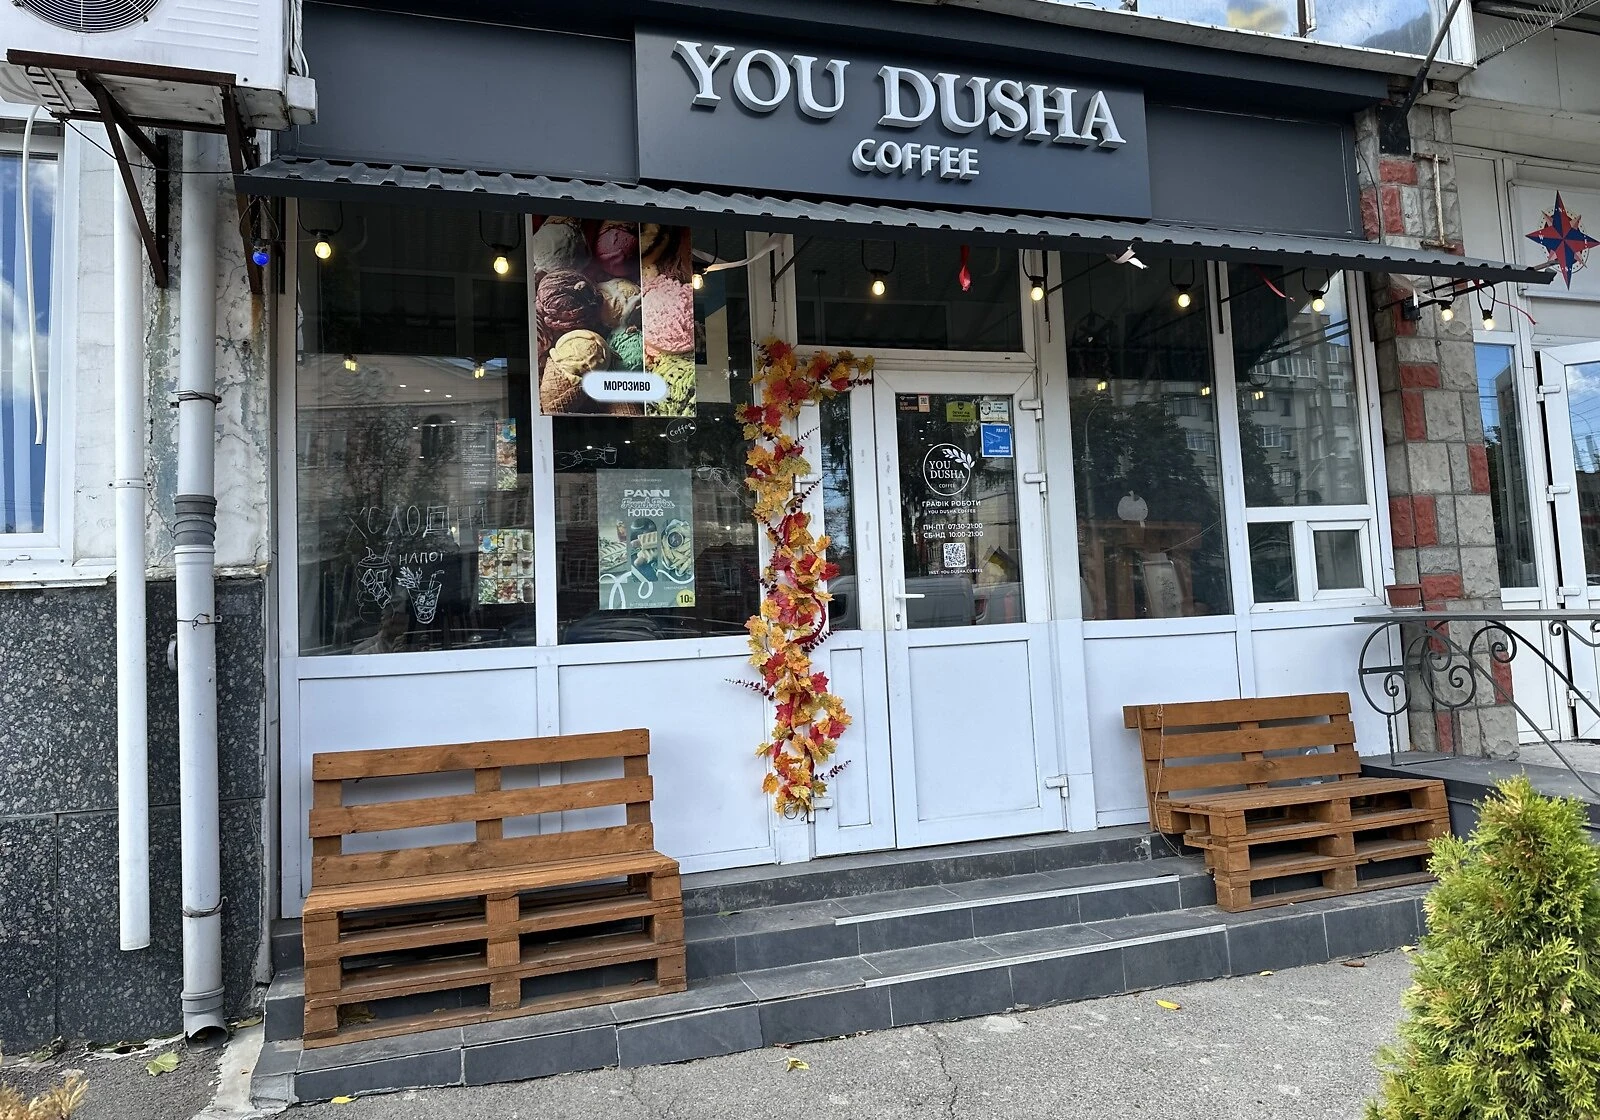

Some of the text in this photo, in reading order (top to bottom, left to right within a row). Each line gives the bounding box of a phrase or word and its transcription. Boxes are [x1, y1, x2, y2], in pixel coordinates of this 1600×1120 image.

[672, 40, 1126, 148] YOU DUSHA
[851, 138, 980, 179] COFFEE
[603, 380, 651, 391] МОРОЗИВО
[669, 422, 692, 437] Coffee
[928, 460, 951, 470] YOU
[930, 470, 966, 479] DUSHA
[624, 489, 670, 498] PANINI
[627, 508, 664, 517] HOTDOG
[923, 522, 983, 531] ПН-ПТ 07:30-21:00
[923, 531, 946, 539] СБ-НД
